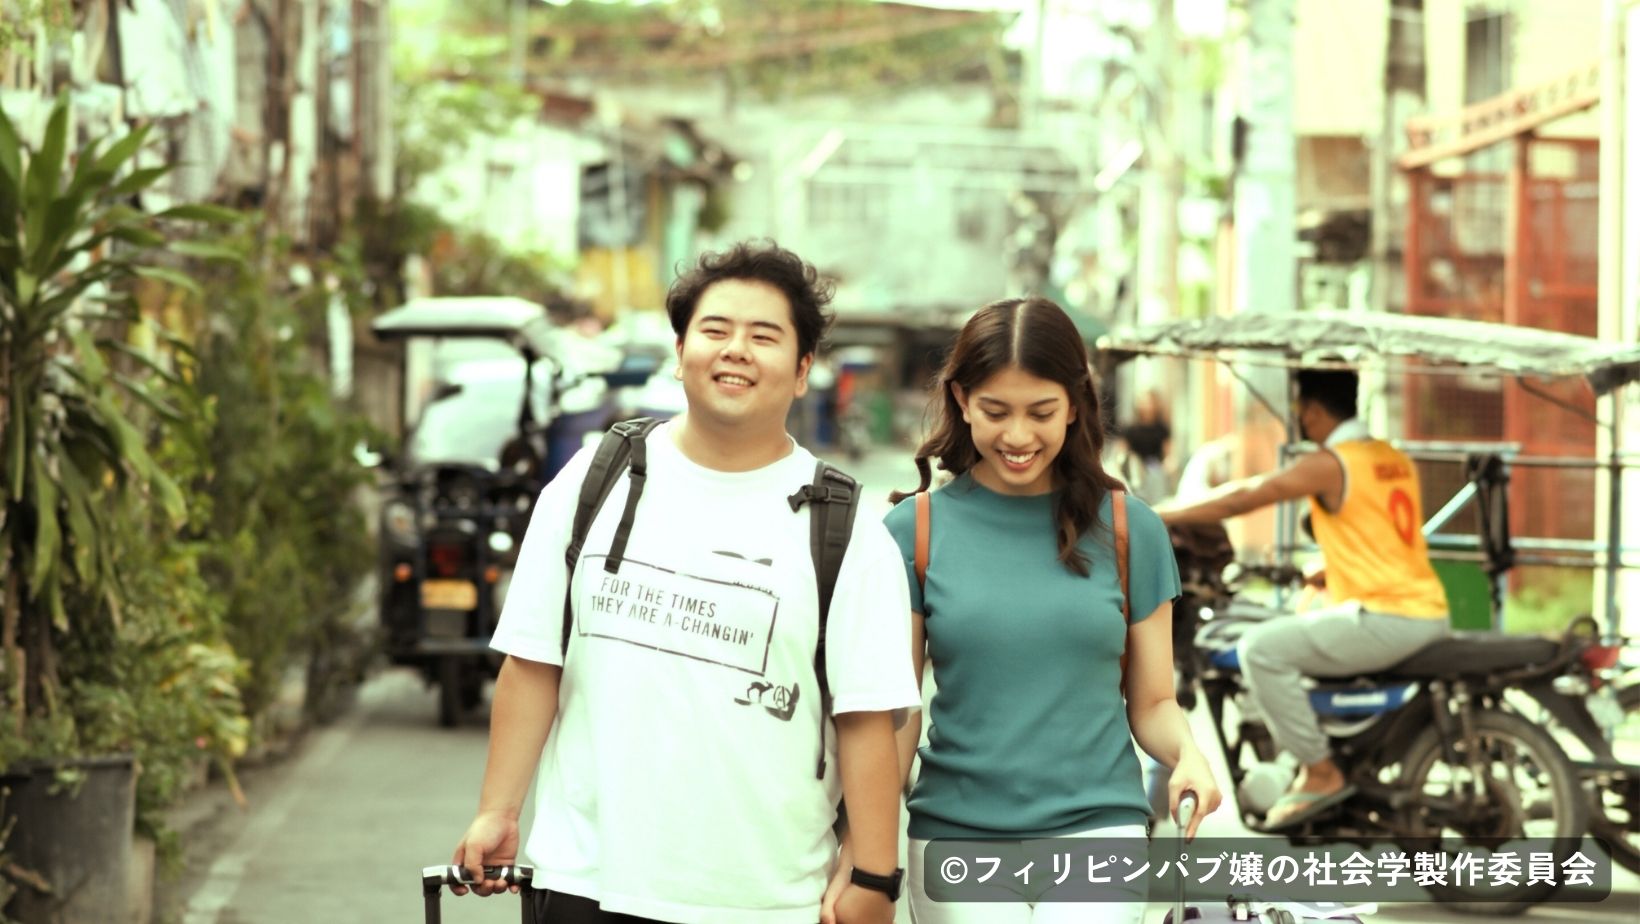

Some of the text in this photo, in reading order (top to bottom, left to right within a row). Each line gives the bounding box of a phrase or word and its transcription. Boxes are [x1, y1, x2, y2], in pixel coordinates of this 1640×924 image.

[591, 595, 623, 615] THEY
[628, 604, 656, 624] ARE
[601, 577, 717, 618] FOR THE TIMES
